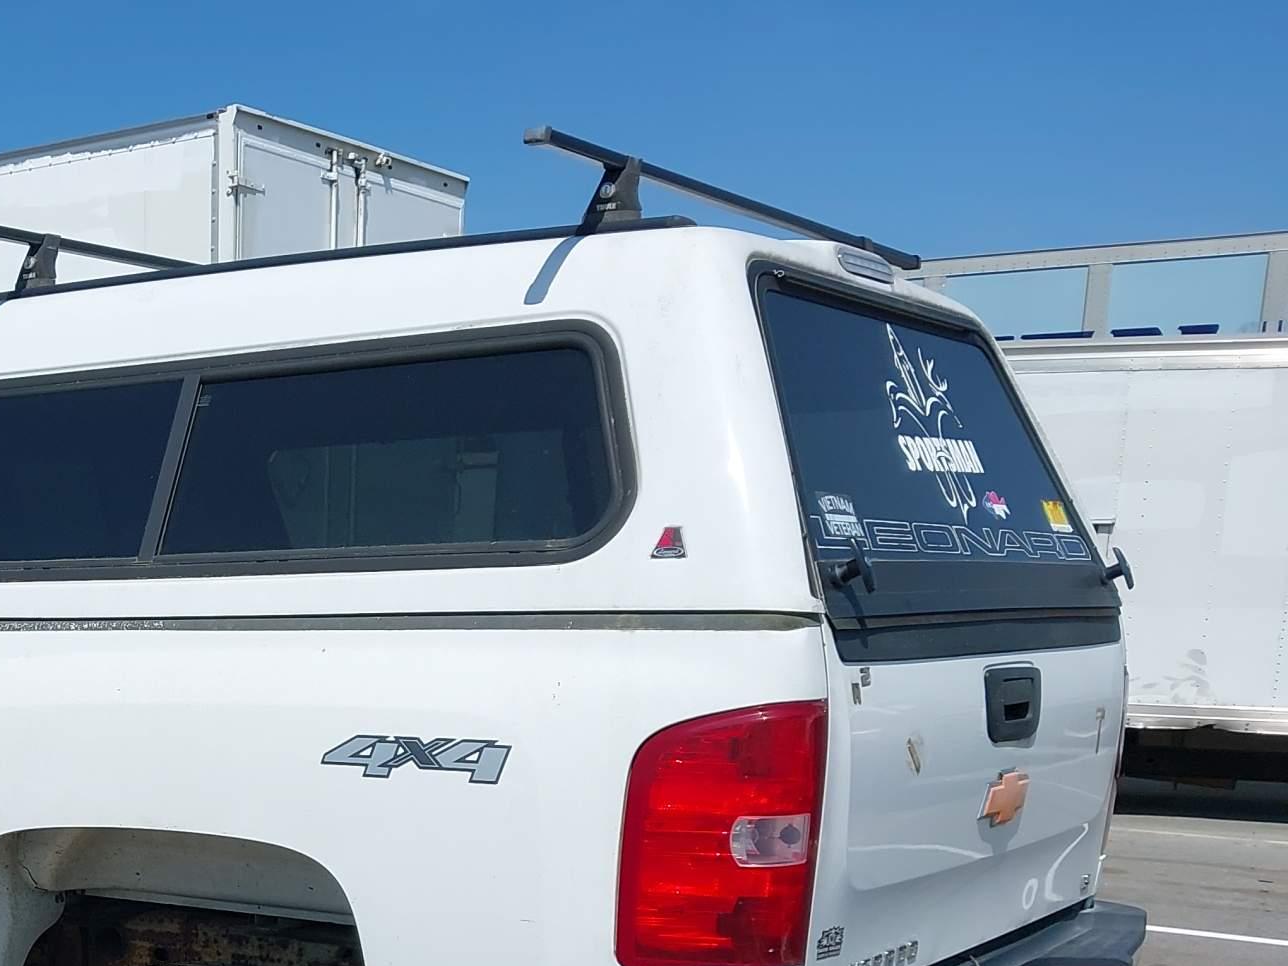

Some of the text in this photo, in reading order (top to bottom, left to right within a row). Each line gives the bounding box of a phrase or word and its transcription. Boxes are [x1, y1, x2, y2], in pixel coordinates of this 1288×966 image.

[898, 434, 985, 474] SPORTSMAN
[818, 495, 855, 515] VIETNAM
[810, 515, 1092, 560] LEONARD
[825, 520, 865, 537] VETERAN
